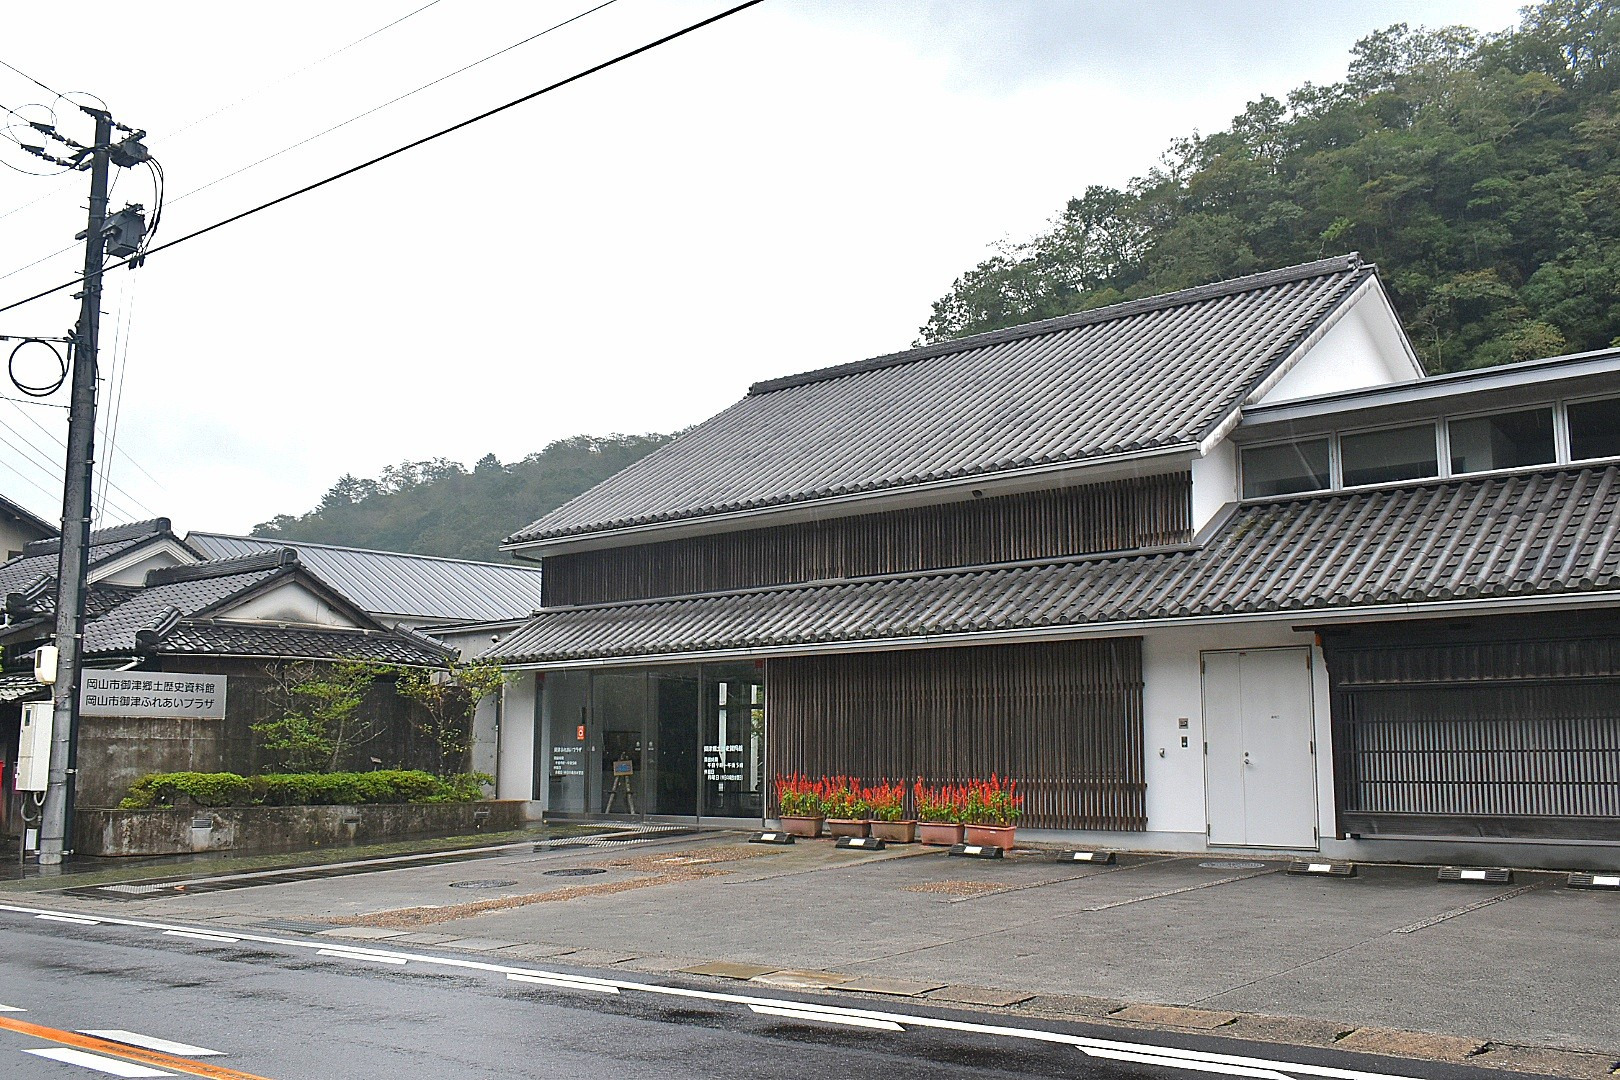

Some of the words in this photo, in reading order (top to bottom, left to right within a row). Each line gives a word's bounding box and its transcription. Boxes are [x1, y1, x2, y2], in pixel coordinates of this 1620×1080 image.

[86, 678, 215, 694] 岡山市御津郷土歴史資料館
[85, 695, 215, 709] 岡山市御津ふれあいプラザ
